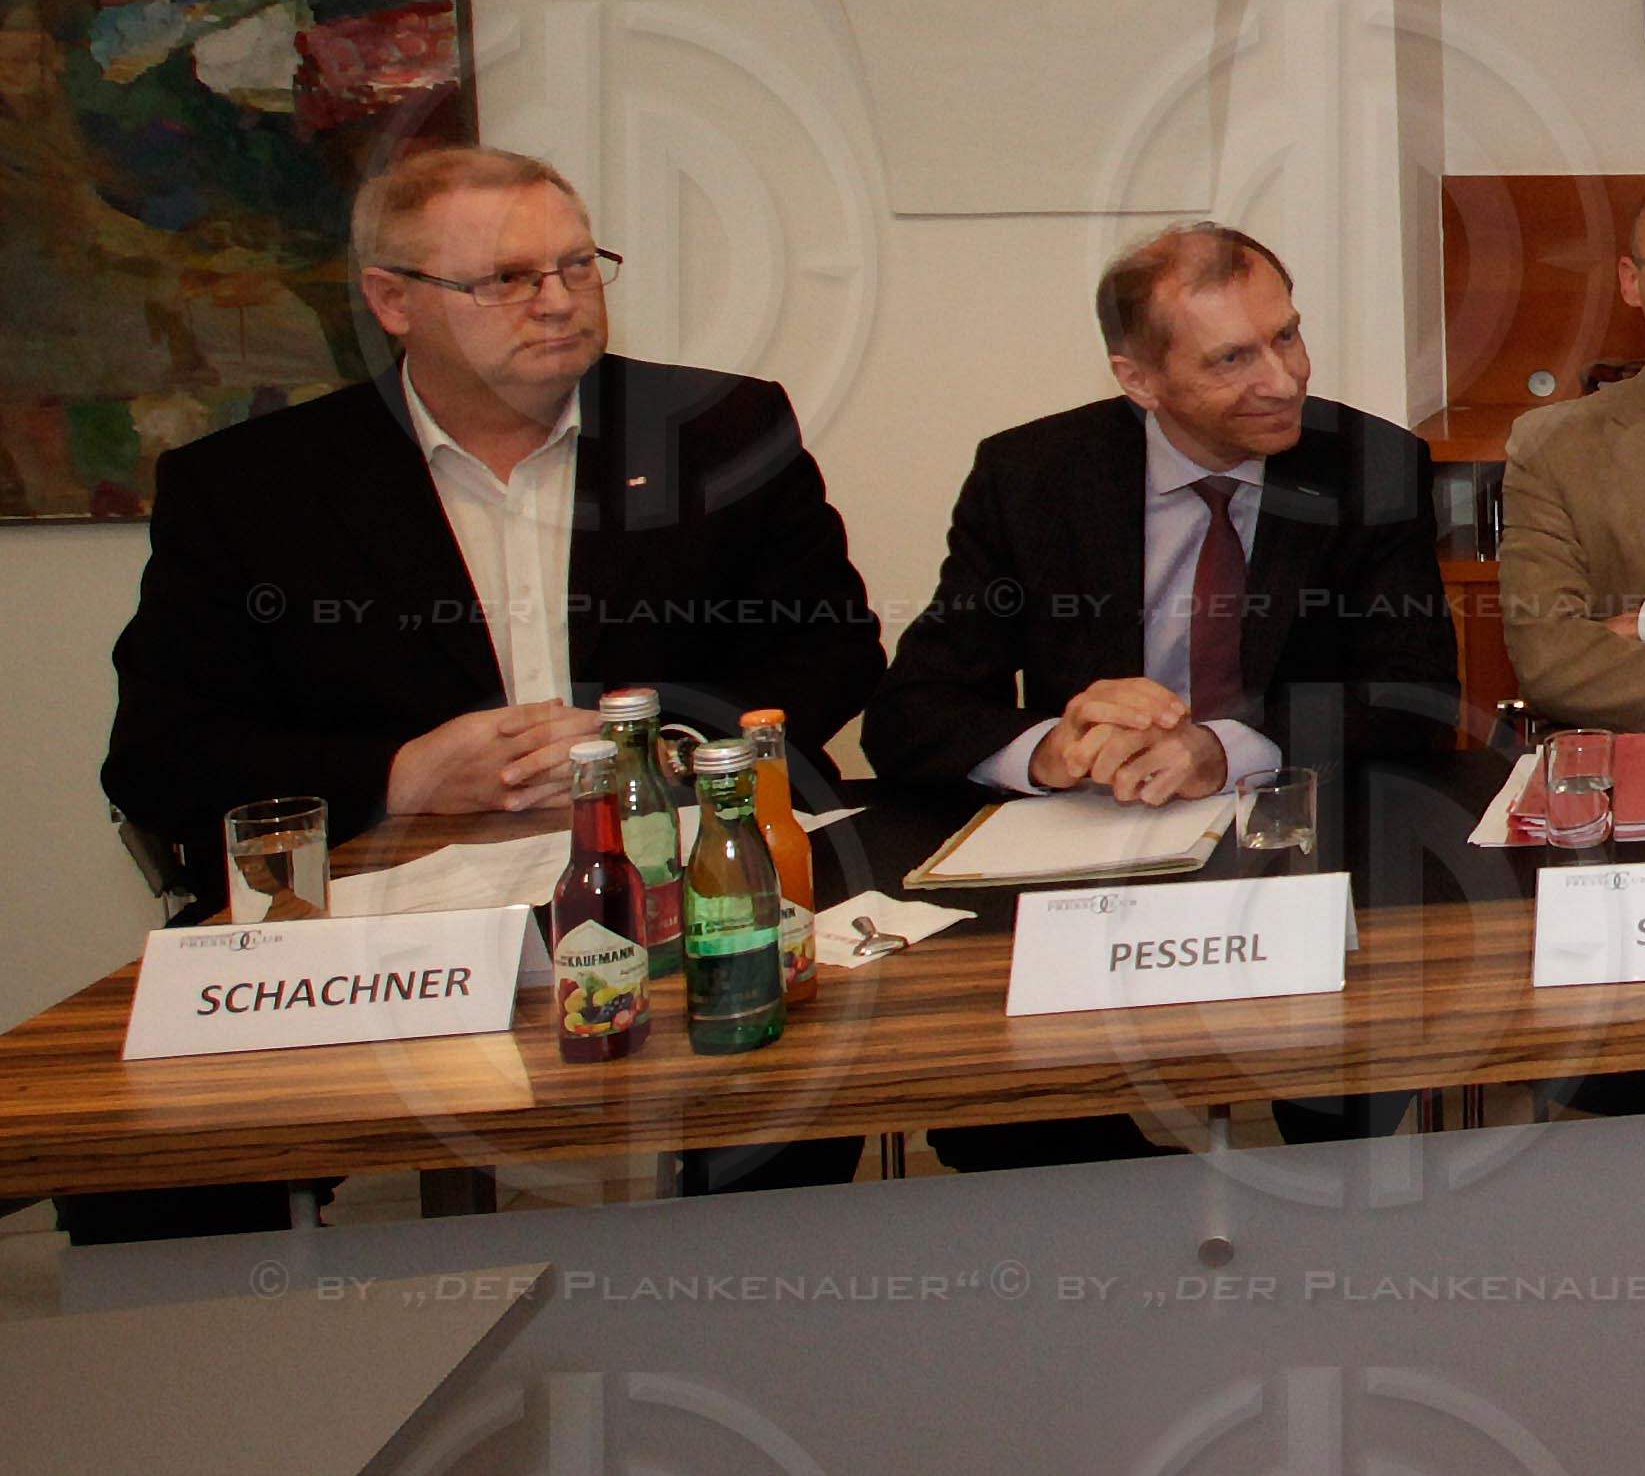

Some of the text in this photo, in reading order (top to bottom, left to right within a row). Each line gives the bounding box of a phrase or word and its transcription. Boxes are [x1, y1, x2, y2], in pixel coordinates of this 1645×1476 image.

[568, 946, 635, 968] KAUFMANN
[1109, 934, 1268, 973] PESSERL
[197, 966, 473, 1016] SCHACHNER
